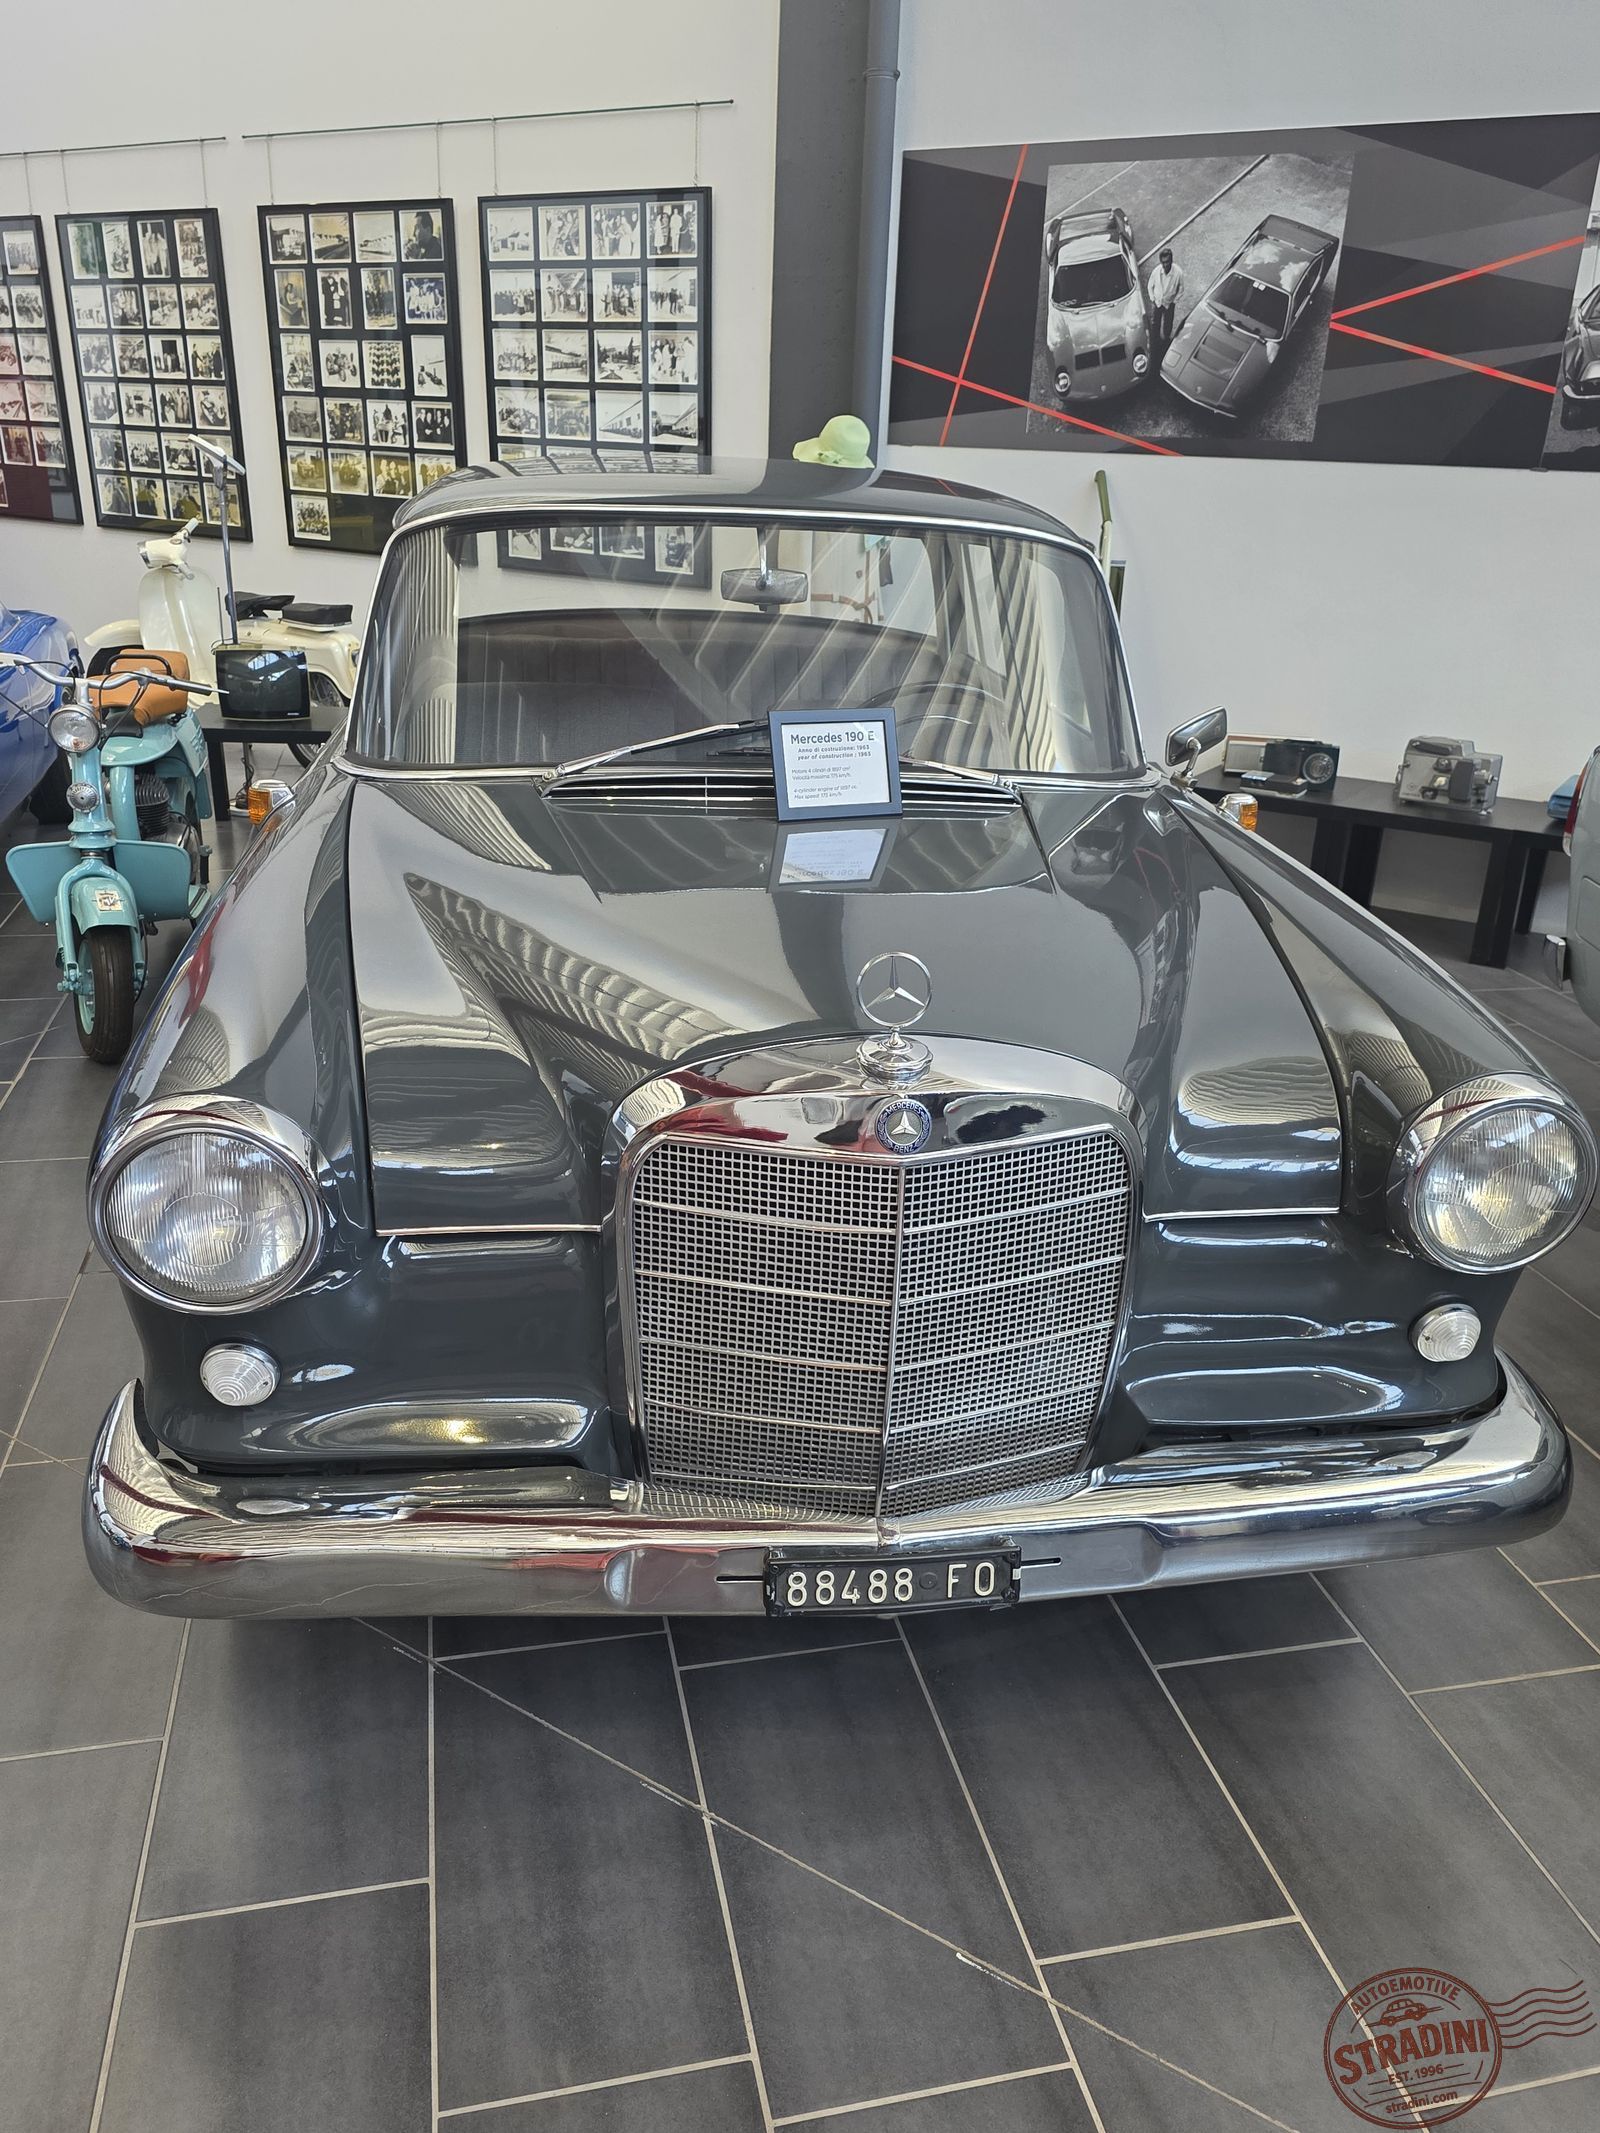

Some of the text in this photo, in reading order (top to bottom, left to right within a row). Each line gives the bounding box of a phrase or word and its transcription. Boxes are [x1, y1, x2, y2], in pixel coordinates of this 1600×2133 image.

[790, 731, 875, 744] Mercedes 190 E
[885, 1101, 923, 1115] MERCEDES
[893, 1144, 915, 1153] BENZ
[787, 1562, 995, 1607] 88488 FO
